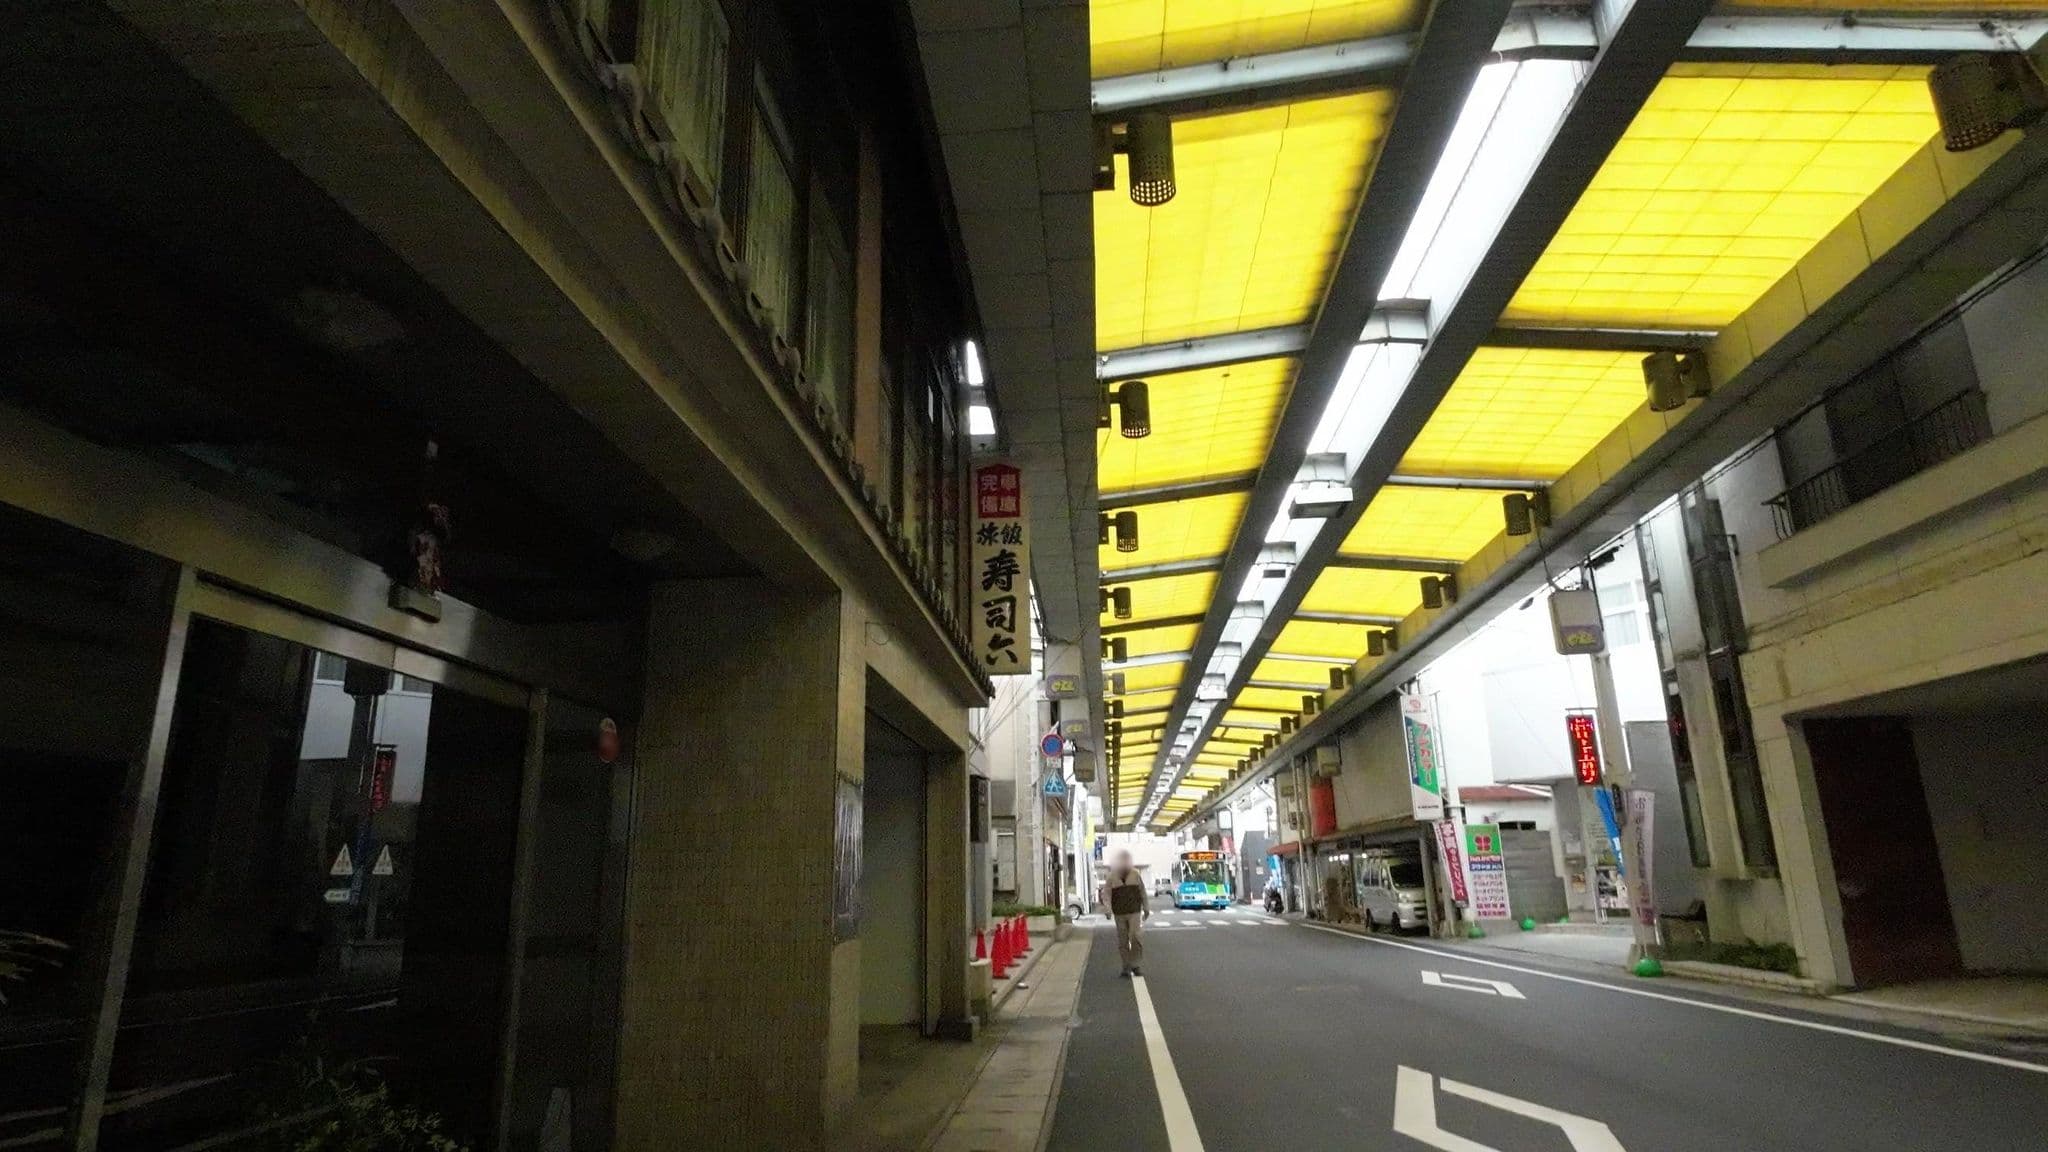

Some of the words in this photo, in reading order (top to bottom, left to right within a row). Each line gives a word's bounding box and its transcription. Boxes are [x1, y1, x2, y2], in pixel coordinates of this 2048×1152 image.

[976, 521, 1023, 546] 旅館
[982, 548, 1020, 665] 寿司六
